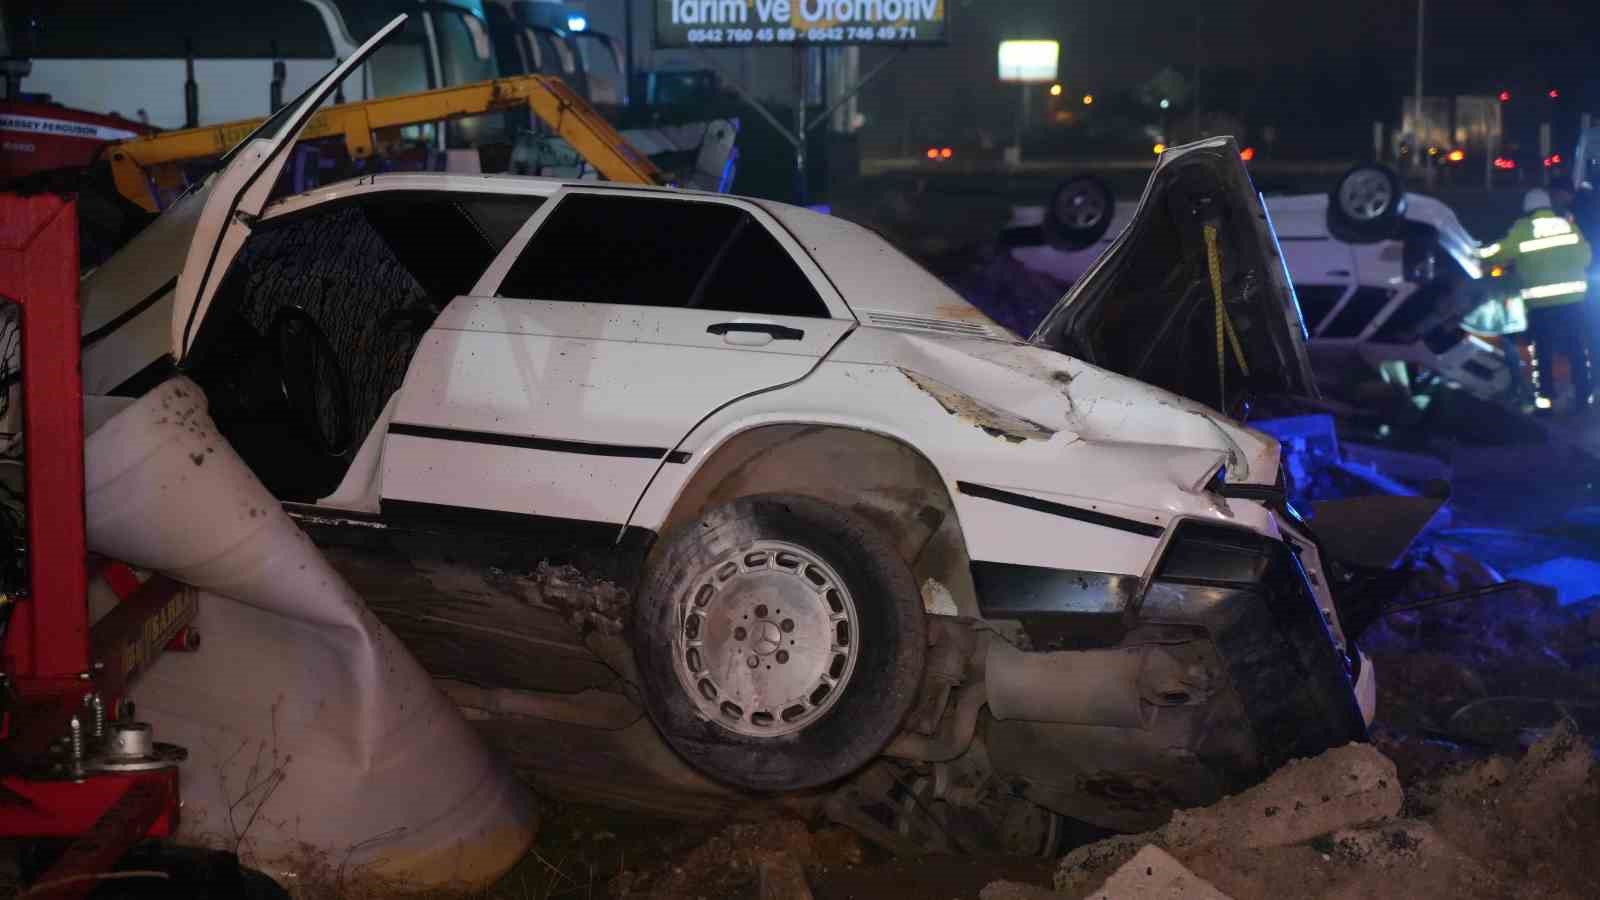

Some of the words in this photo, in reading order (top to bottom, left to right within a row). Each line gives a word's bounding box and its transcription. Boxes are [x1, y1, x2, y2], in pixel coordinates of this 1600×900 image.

[687, 28, 722, 42] 0542
[756, 28, 774, 42] 45
[807, 27, 844, 42] 0542
[877, 26, 897, 40] 49
[899, 26, 917, 40] 71
[42, 121, 97, 138] FERGUSON
